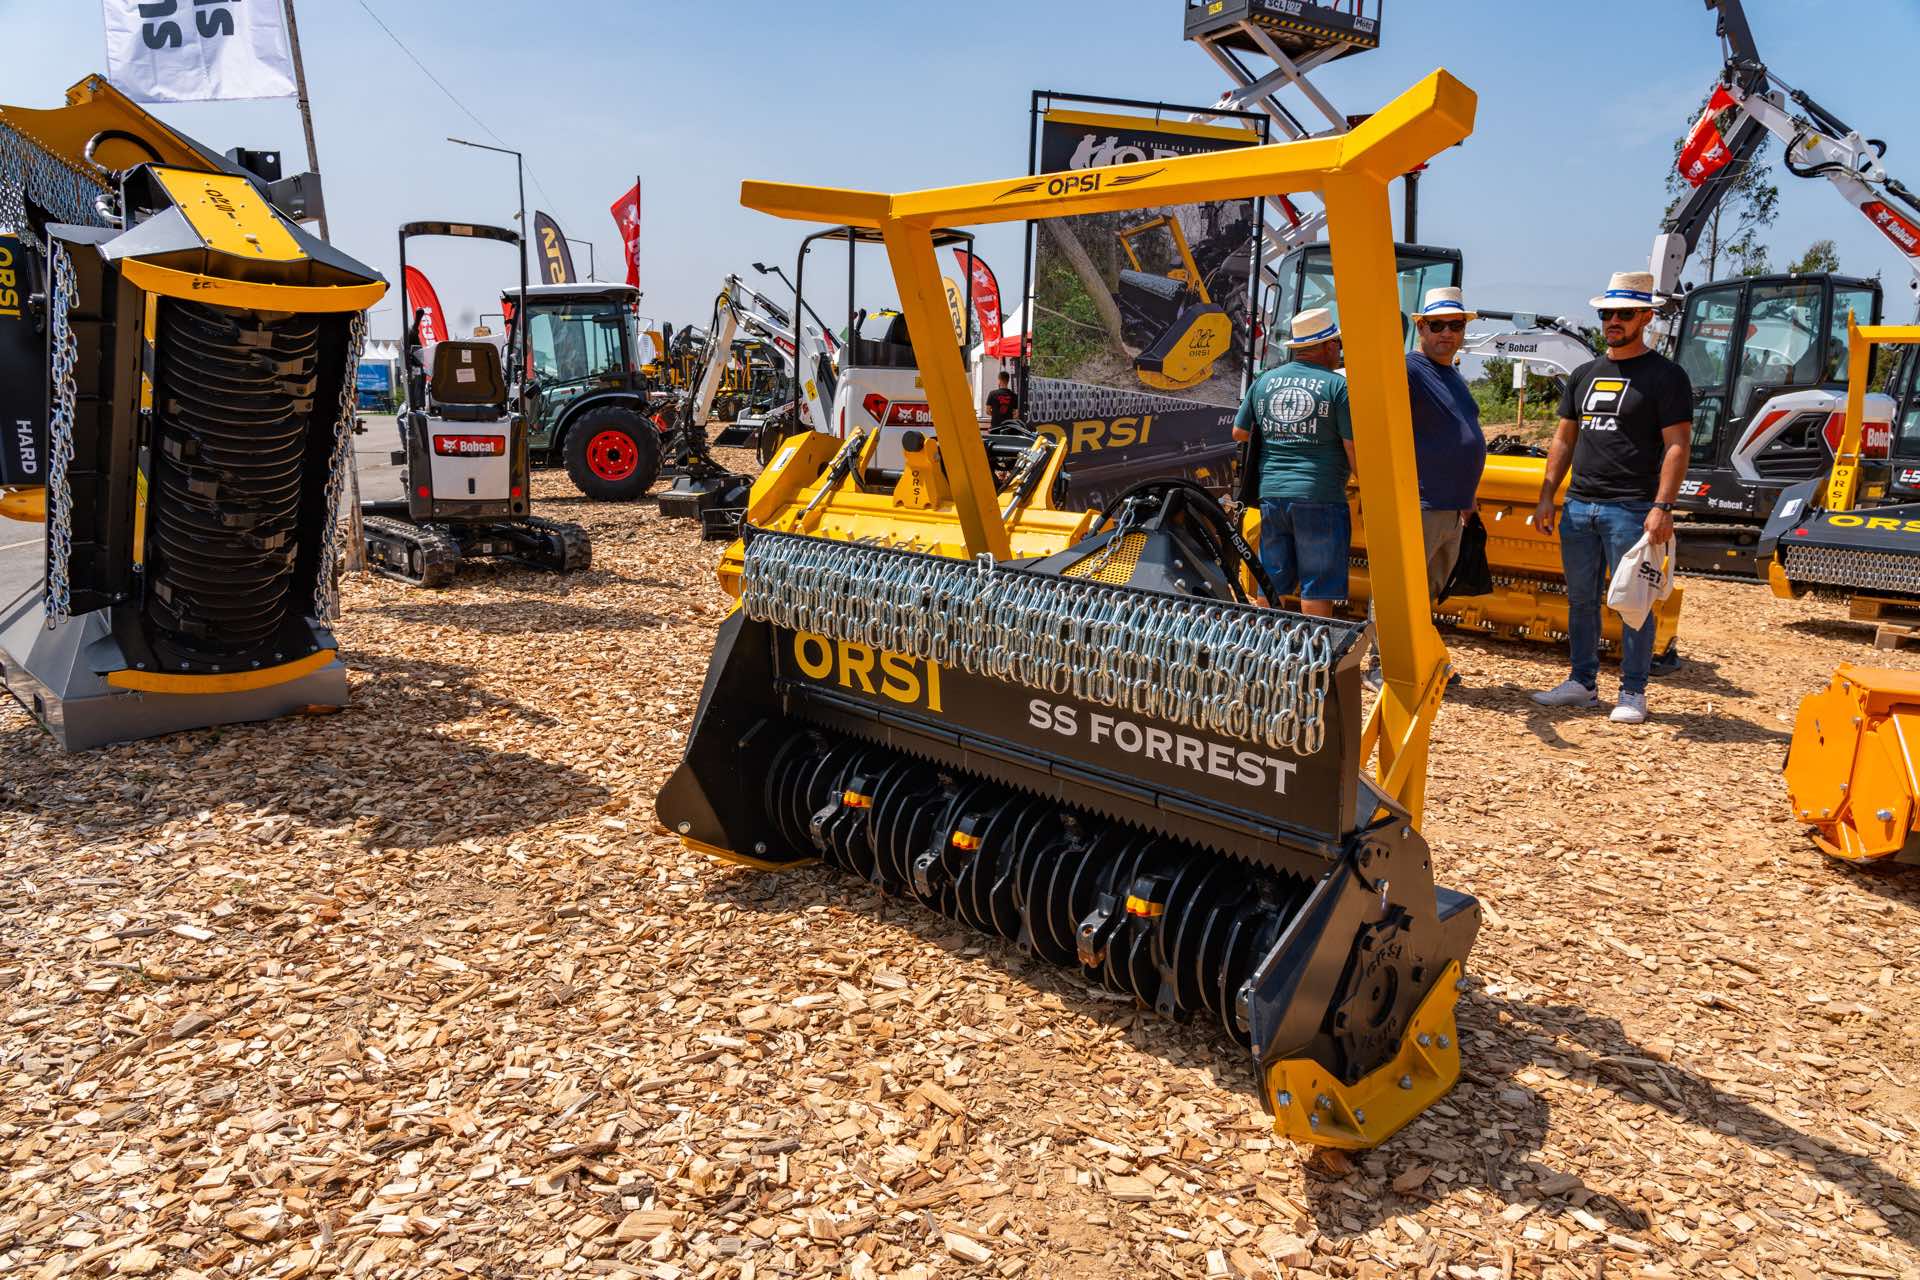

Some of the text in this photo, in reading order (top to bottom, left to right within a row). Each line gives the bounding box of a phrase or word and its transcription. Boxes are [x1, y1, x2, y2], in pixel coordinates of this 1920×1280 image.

[1886, 221, 1918, 248] Bobcat
[1508, 343, 1538, 353] Bobcat
[1265, 377, 1325, 395] COURAGE
[1581, 415, 1618, 431] FILA
[16, 419, 38, 475] HARD
[460, 440, 496, 453] Bobcat
[911, 470, 920, 505] ORSI
[1832, 468, 1849, 511] ORSI
[1718, 500, 1743, 510] Bobcat
[1230, 533, 1252, 560] ORSI
[794, 631, 944, 713] ORSI
[1028, 698, 1297, 796] SS FORREST
